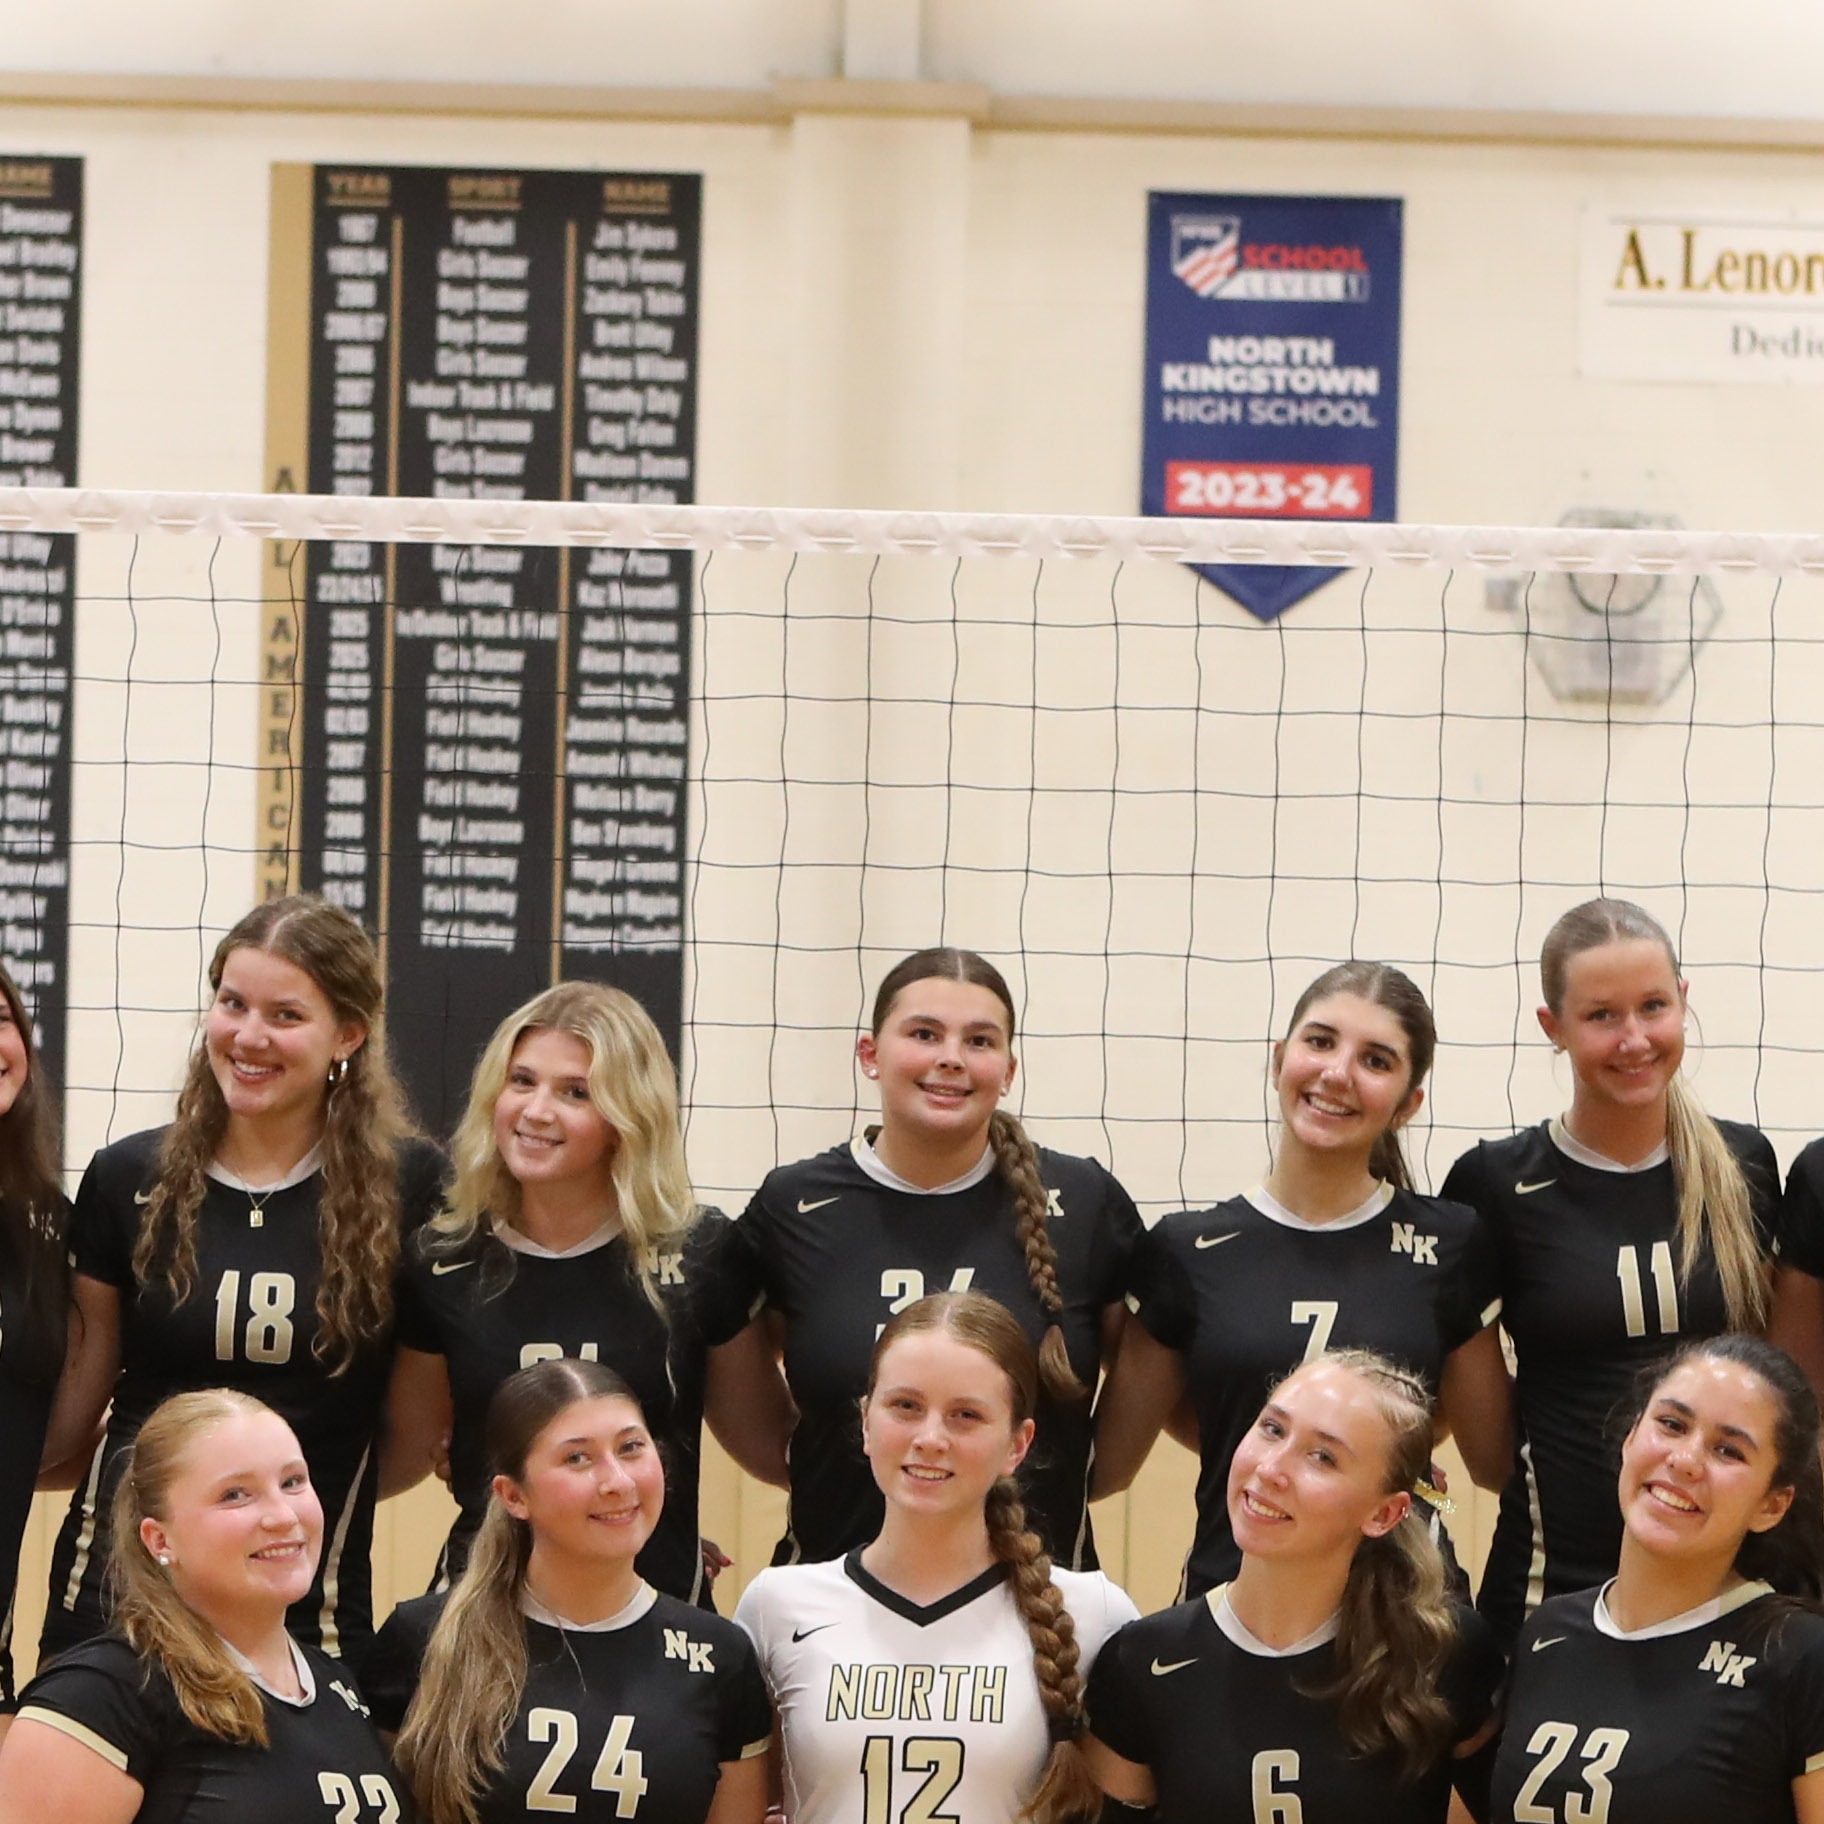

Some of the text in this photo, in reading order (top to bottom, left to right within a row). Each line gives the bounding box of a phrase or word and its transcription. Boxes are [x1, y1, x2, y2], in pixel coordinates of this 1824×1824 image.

[1242, 243, 1369, 271] SCHOOL
[1612, 227, 1666, 292] A.
[1209, 336, 1334, 366] NORTH
[1162, 363, 1379, 395] KINGSTOWN
[1163, 396, 1378, 428] HIGH SCHOOL
[1177, 470, 1361, 510] 2023-24
[1390, 1222, 1439, 1266] NK
[1617, 1241, 1680, 1338] 11
[215, 1269, 296, 1364] 18
[1290, 1301, 1339, 1363] 7
[663, 1628, 715, 1674] NK
[1698, 1640, 1757, 1689] NK
[825, 1663, 1007, 1723] NORTH
[526, 1706, 649, 1819] 24
